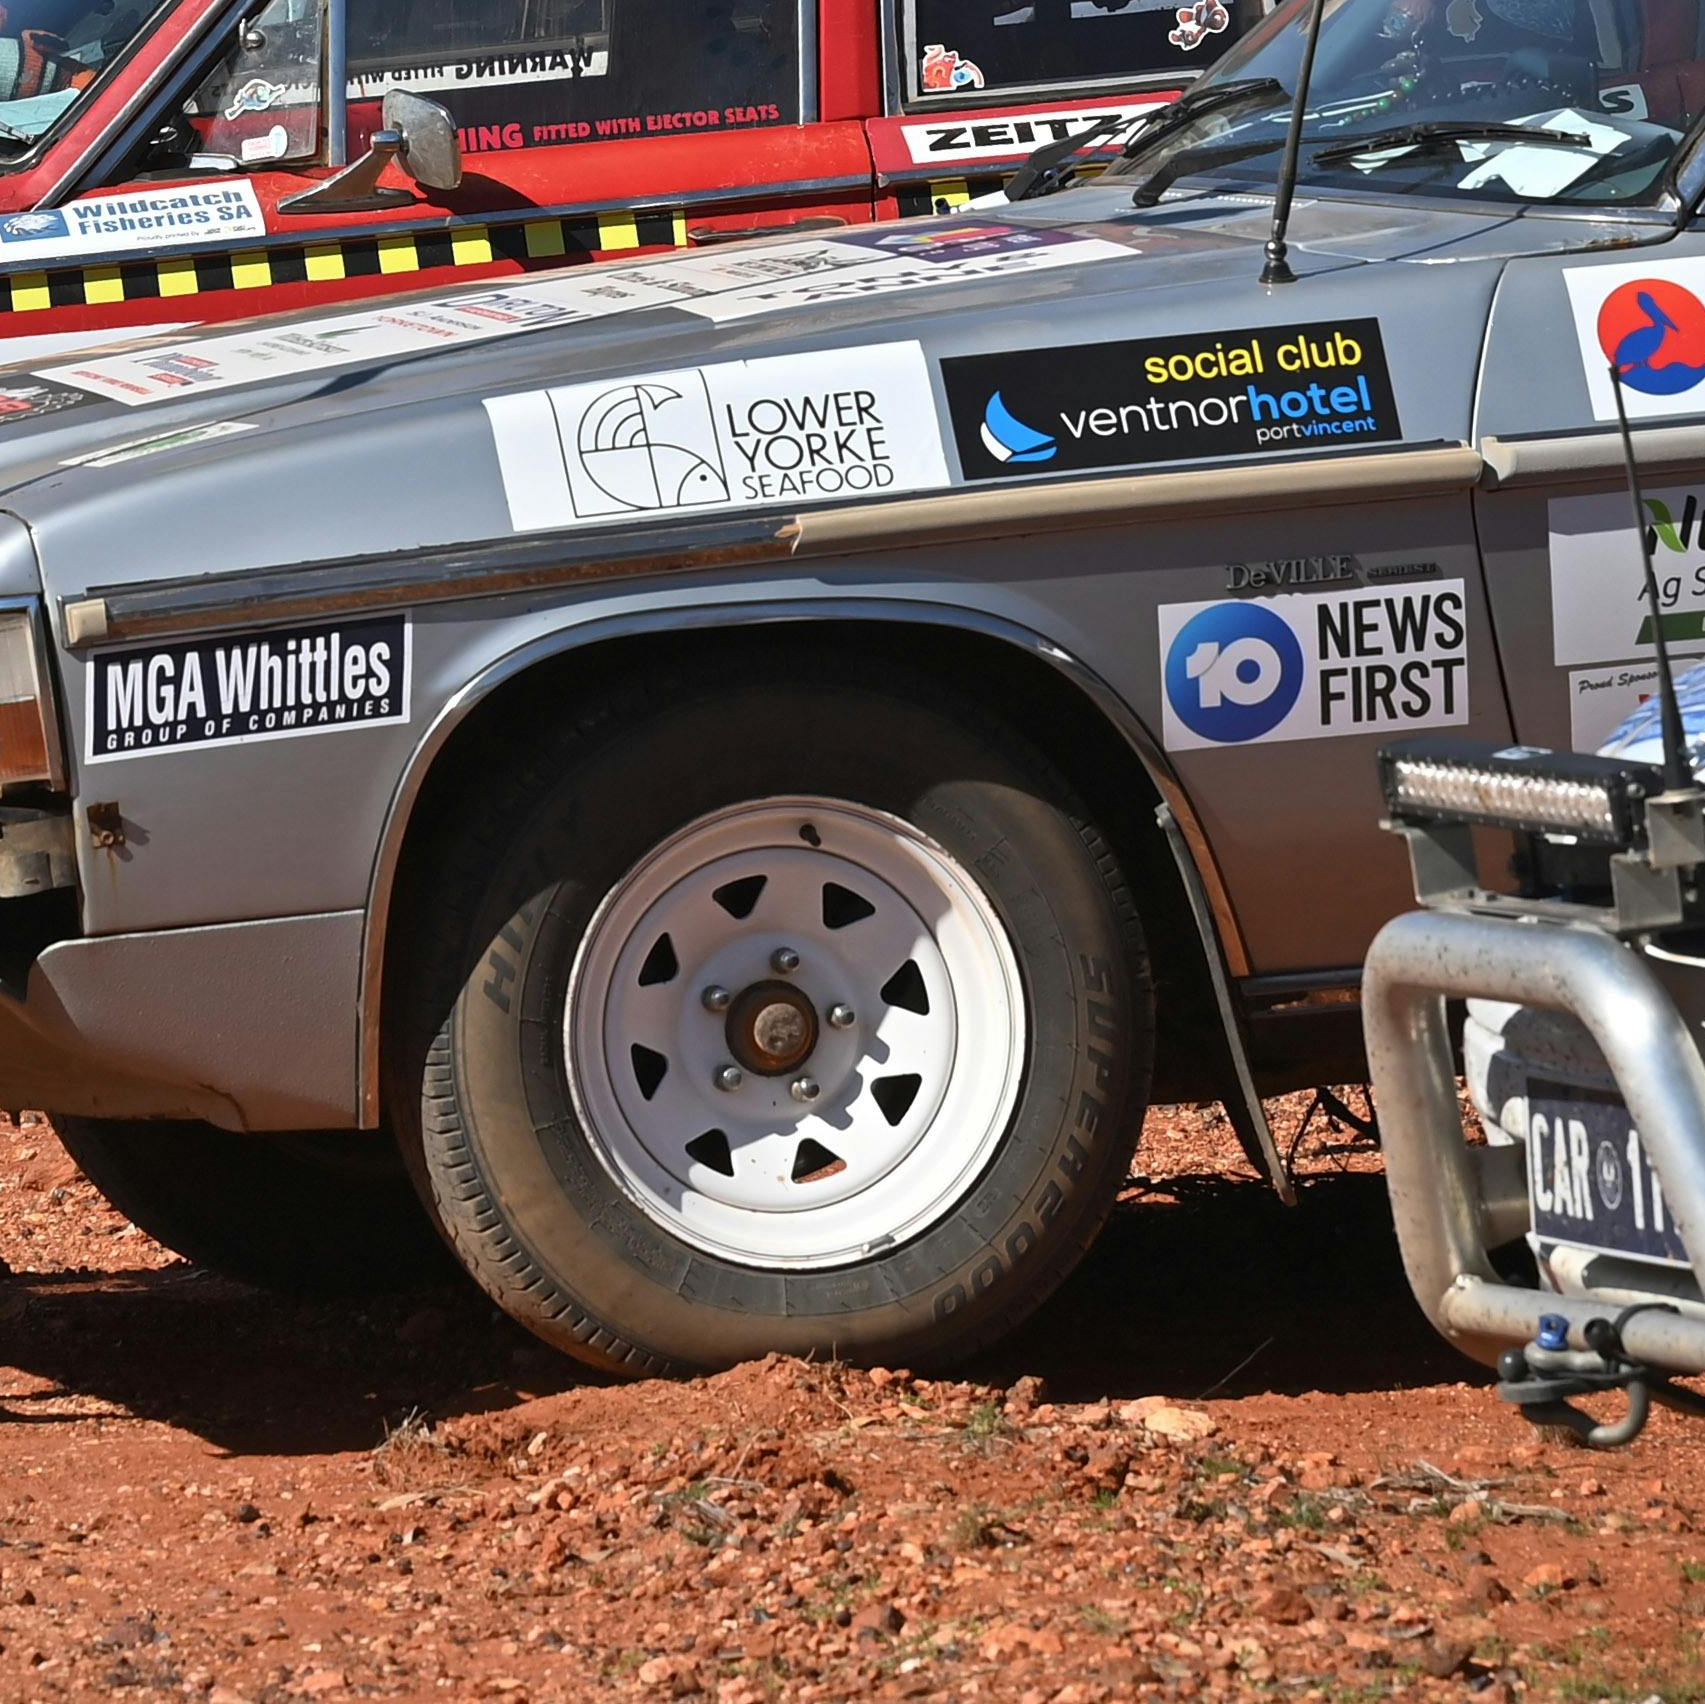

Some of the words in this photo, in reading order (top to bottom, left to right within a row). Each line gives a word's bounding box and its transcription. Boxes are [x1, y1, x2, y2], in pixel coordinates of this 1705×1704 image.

[533, 121, 592, 140] FITTED
[596, 115, 643, 136] WITH
[645, 106, 721, 132] EJECTOR
[724, 103, 780, 125] SEATS
[72, 189, 244, 220] Wildcatch
[78, 209, 211, 236] Fisheries
[218, 204, 253, 222] SA
[1144, 339, 1265, 384] social
[1276, 331, 1363, 375] club
[727, 389, 883, 438] LOWER
[1061, 374, 1373, 441] ventnorhotel
[1256, 415, 1377, 445] portvincent
[733, 425, 892, 473] YORKE
[742, 462, 895, 501] SEAFOOD
[1226, 554, 1354, 592] DeVILLE
[1637, 571, 1682, 608] Ag
[1317, 591, 1465, 661] NEWS
[106, 651, 207, 730] MGA
[214, 631, 391, 715] Whittles
[1185, 637, 1282, 709] 10
[1318, 656, 1465, 726] FIRST
[1577, 676, 1614, 695] Proud
[107, 724, 188, 750] GROUP
[204, 717, 232, 736] OF
[248, 697, 391, 731] COMPANIES
[1529, 1111, 1595, 1222] CAR
